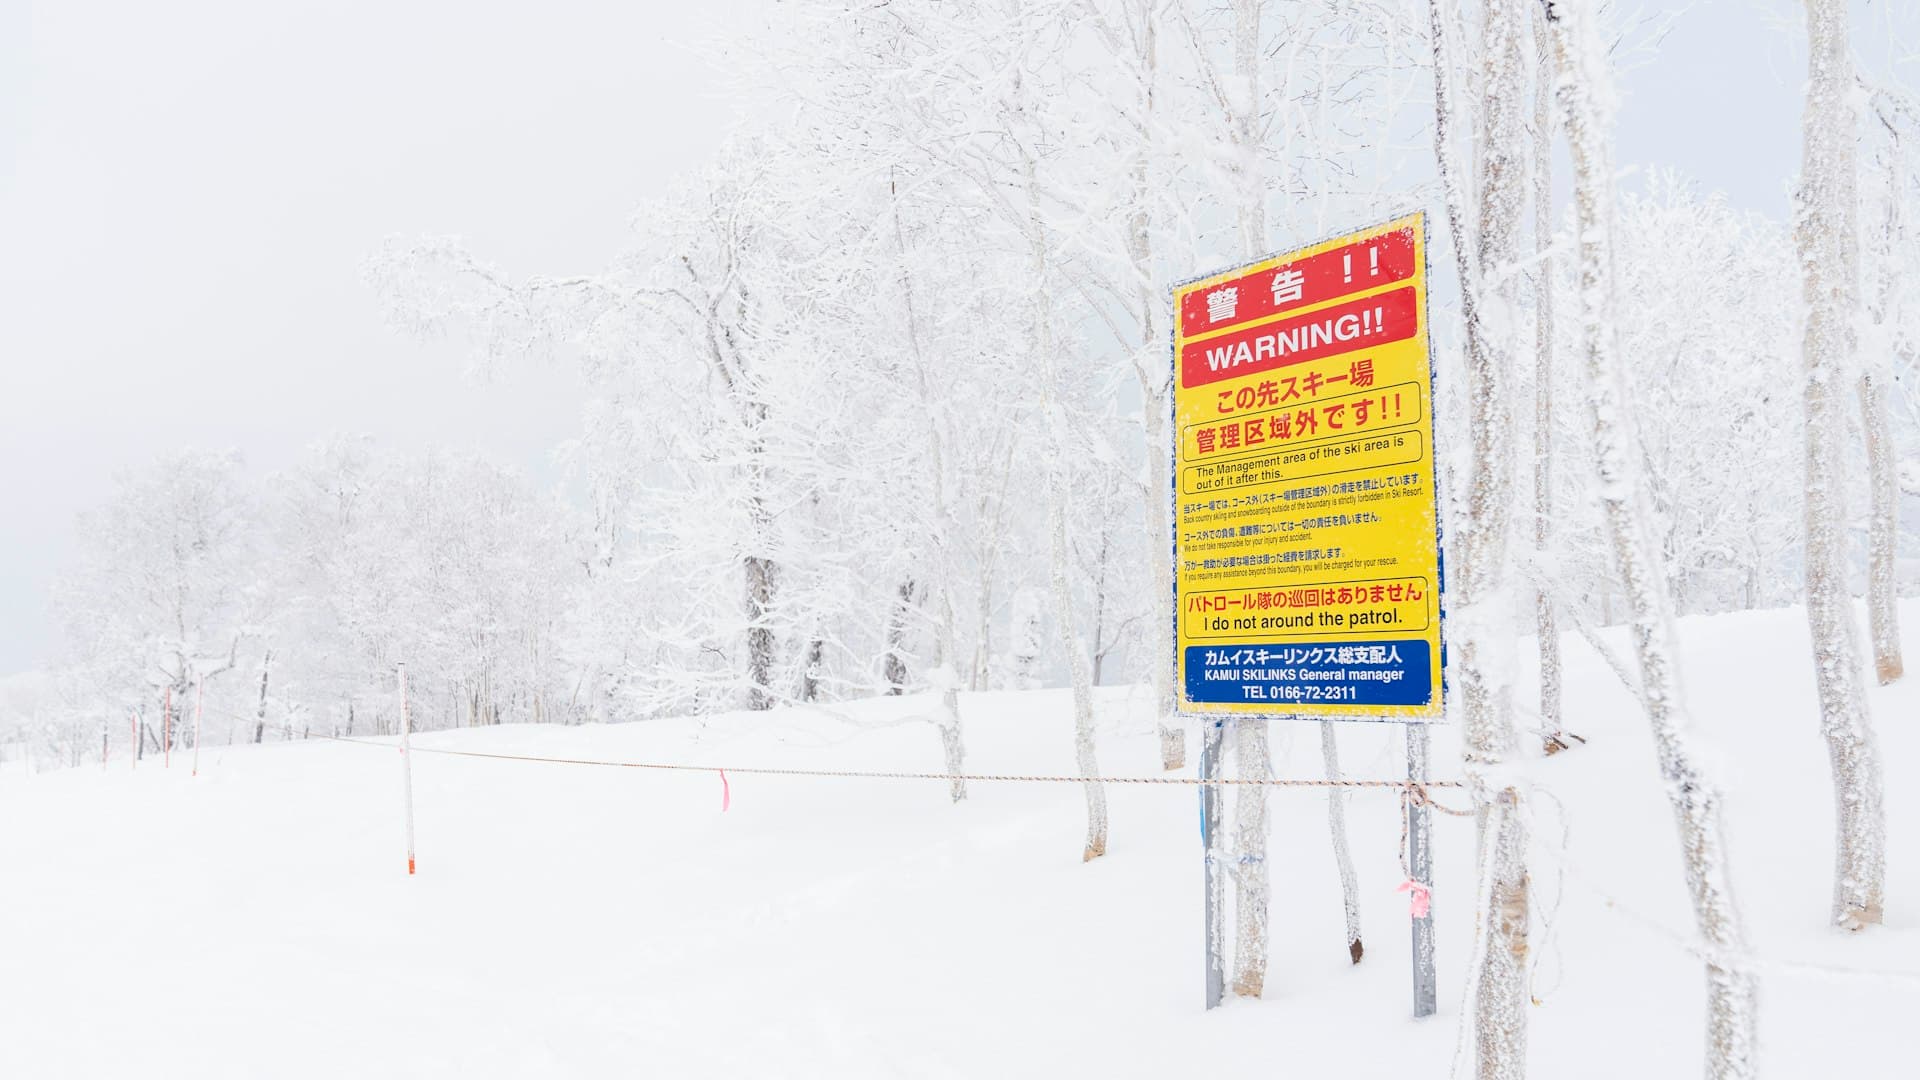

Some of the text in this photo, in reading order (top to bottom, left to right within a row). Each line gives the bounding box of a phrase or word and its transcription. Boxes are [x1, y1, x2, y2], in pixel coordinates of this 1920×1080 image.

[1205, 307, 1383, 372] WARNING!!
[1217, 358, 1374, 414] この先スキー場
[1196, 393, 1401, 455] 管理区域外です!!
[1196, 436, 1404, 478] The Management area of the ski area is
[1196, 470, 1284, 490] out of it after this.
[1184, 515, 1194, 524] Back
[1195, 514, 1212, 523] country
[1213, 512, 1227, 521] skiing
[1228, 510, 1237, 518] and
[1237, 506, 1271, 516] snowboarding
[1271, 503, 1290, 512] outside
[1306, 499, 1331, 508] boundary
[1338, 496, 1356, 505] strictly
[1357, 492, 1384, 502] forbidden
[1392, 489, 1400, 498] Ski
[1402, 487, 1424, 497] Resort.
[1198, 543, 1206, 551] not
[1206, 542, 1216, 550] take
[1216, 539, 1244, 550] responsible
[1252, 538, 1263, 547] your
[1263, 536, 1278, 545] injury
[1279, 534, 1288, 542] and
[1289, 532, 1312, 542] accident.
[1188, 573, 1197, 582] you
[1197, 571, 1213, 580] require
[1214, 571, 1222, 579] any
[1223, 569, 1248, 578] assistance
[1248, 568, 1266, 577] beyond
[1267, 566, 1277, 574] this
[1278, 564, 1302, 574] boundary,
[1303, 564, 1313, 573] you
[1331, 560, 1353, 570] charged
[1363, 559, 1376, 569] your
[1377, 557, 1398, 565] rescue.
[1188, 583, 1422, 613] パトロール隊の巡回はありません
[1212, 616, 1229, 630] do
[1234, 615, 1257, 629] not
[1261, 611, 1314, 628] around
[1318, 610, 1344, 626] the
[1349, 608, 1403, 628] patrol.
[1205, 645, 1402, 666] カムイスキーリンクス総支配人
[1205, 669, 1404, 682] KAMUI SKILINKS General manager
[1242, 685, 1356, 699] TEL 0166-72-2311
